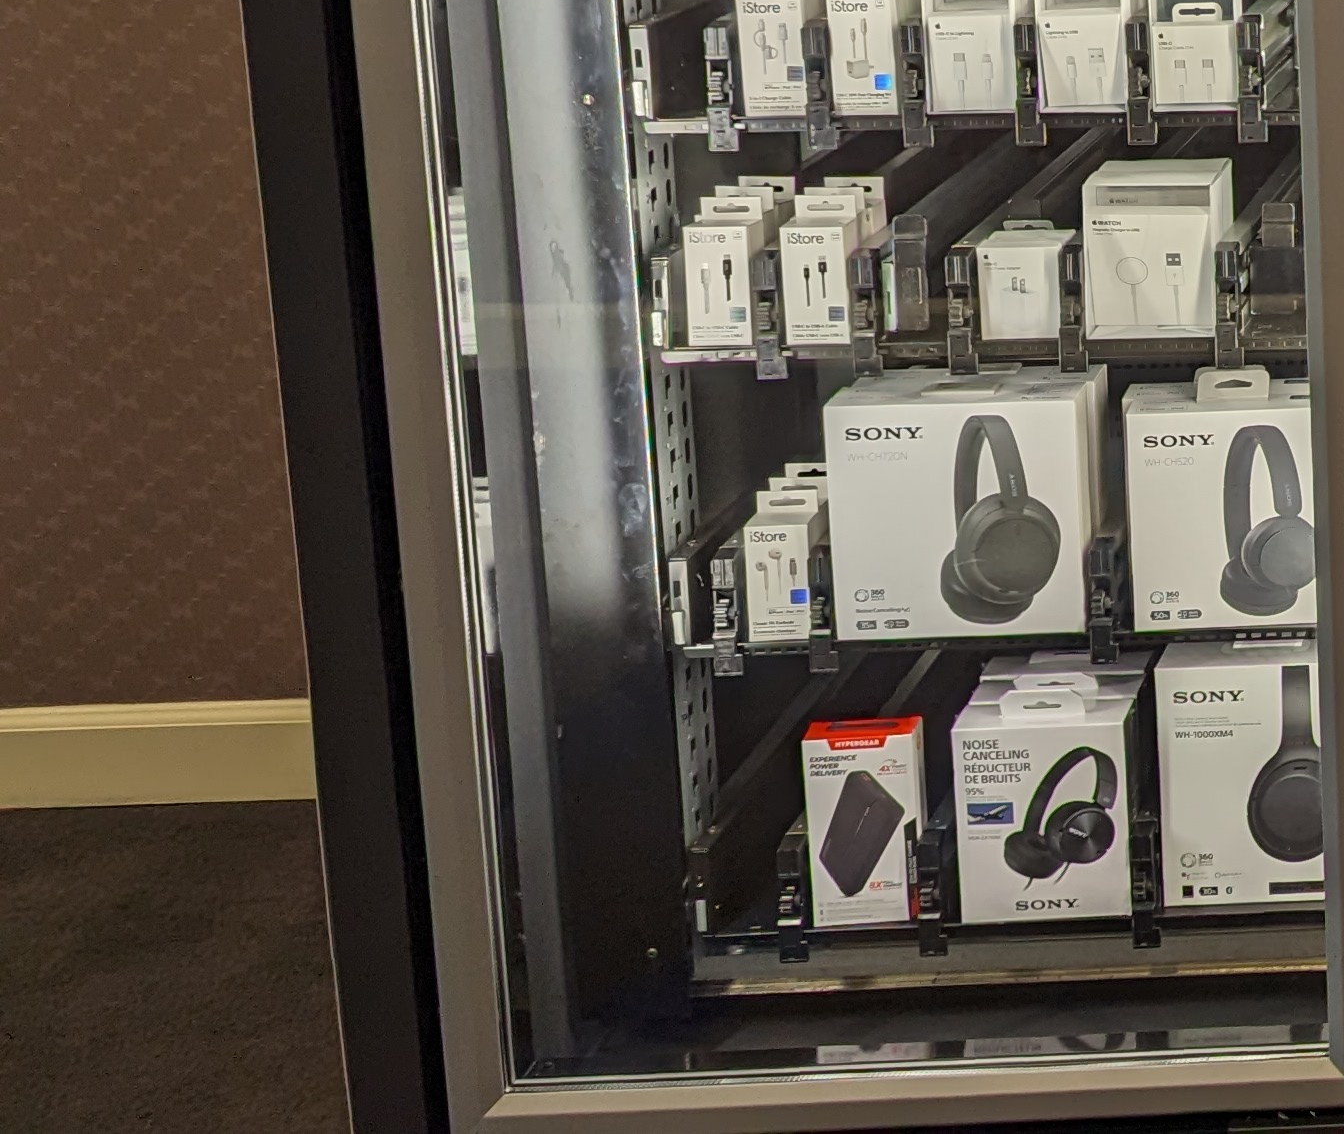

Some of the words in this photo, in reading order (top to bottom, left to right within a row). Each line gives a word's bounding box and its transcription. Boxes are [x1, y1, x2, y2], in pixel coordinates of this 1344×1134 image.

[743, 2, 781, 14] iStore
[830, 1, 868, 12] iStore
[689, 232, 726, 243] iStore
[787, 233, 824, 244] iStore
[845, 426, 922, 442] SONY
[1143, 433, 1214, 449] SONY
[846, 449, 908, 463] WH-CH720N
[749, 531, 787, 543] iStore
[1173, 690, 1243, 704] SONY
[1175, 730, 1234, 739] WH-1000XM4
[834, 739, 880, 748] HYPERGEAR
[962, 739, 999, 750] NOISE
[809, 754, 858, 763] EXPERIENCE
[962, 749, 1030, 761] CANCELING
[809, 762, 840, 770] POWER
[963, 762, 1032, 774] RÉDUCTEUR
[809, 769, 849, 777] DELIVERY
[964, 775, 980, 784] DE
[981, 773, 1022, 784] BRUITS
[1015, 898, 1078, 911] SONY
